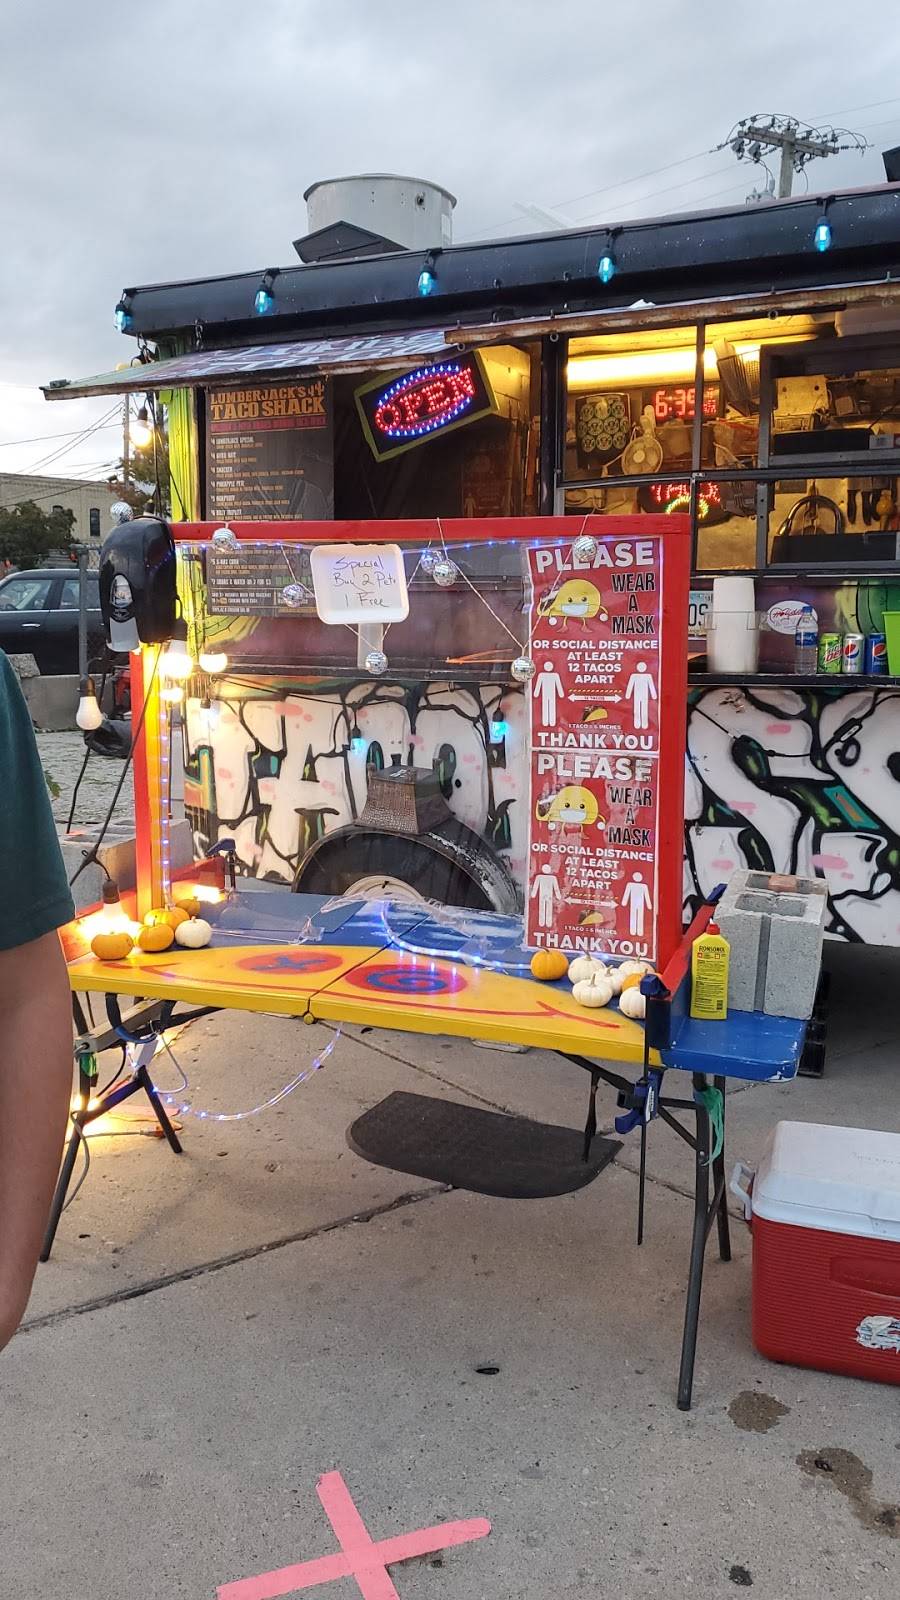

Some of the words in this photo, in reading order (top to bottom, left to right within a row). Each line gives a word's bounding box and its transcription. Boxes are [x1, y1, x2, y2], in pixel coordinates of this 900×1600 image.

[210, 386, 306, 404] LUMBERJACK'S
[374, 365, 475, 432] OPEN
[210, 401, 259, 420] TACO
[262, 397, 326, 417] SHACK
[333, 555, 384, 578] Special
[333, 572, 368, 593] Buy
[362, 573, 375, 586] 2
[611, 572, 656, 592] WEAR
[344, 593, 349, 609] 1
[355, 591, 390, 608] Free
[628, 594, 639, 614] A
[611, 615, 656, 635] MASK
[532, 640, 549, 649] OR
[552, 640, 596, 650] SOCIAL
[598, 640, 658, 650] DISTANCE
[567, 651, 582, 661] AT
[584, 651, 624, 661] LEAST
[567, 663, 579, 673] 12
[582, 663, 622, 673] TACOS
[574, 674, 615, 684] APART
[537, 732, 607, 749] THANK
[612, 734, 653, 750] YOU
[537, 753, 653, 782] PLEASE
[609, 786, 653, 806] WEAR
[625, 807, 635, 825] A
[608, 826, 651, 847] MASK
[531, 843, 548, 853] OR
[550, 844, 594, 856] SOCIAL
[596, 848, 654, 862] DISTANCE
[564, 857, 580, 866] AT
[582, 858, 620, 869] LEAST
[566, 867, 577, 876] 12
[580, 868, 618, 880] TACOS
[572, 879, 612, 890] APART
[533, 932, 603, 954] THANK
[607, 938, 648, 957] YOU
